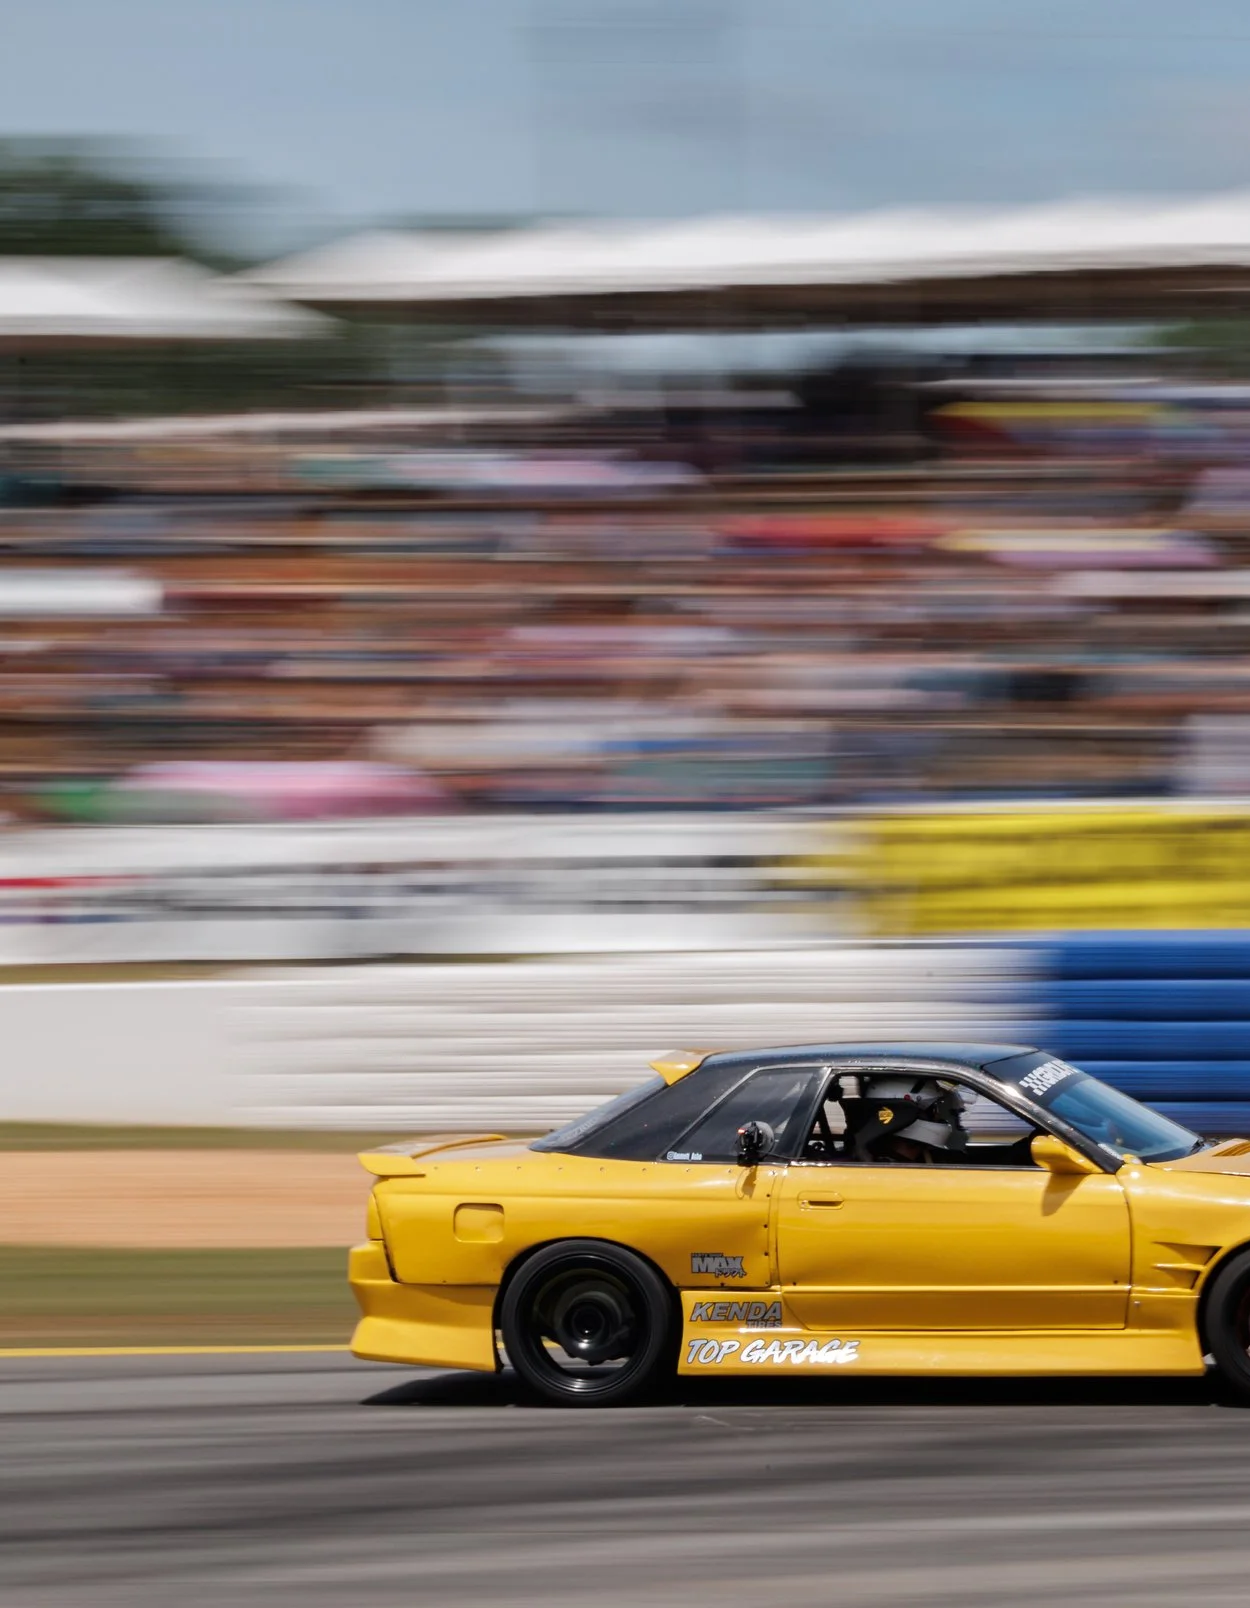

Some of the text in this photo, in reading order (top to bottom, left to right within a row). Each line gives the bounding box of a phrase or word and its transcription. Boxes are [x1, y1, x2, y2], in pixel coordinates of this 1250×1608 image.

[691, 1256, 744, 1273] MAX
[690, 1302, 782, 1321] KENDA
[746, 1320, 782, 1329] TIRES
[688, 1339, 861, 1364] TOP GARAGE
